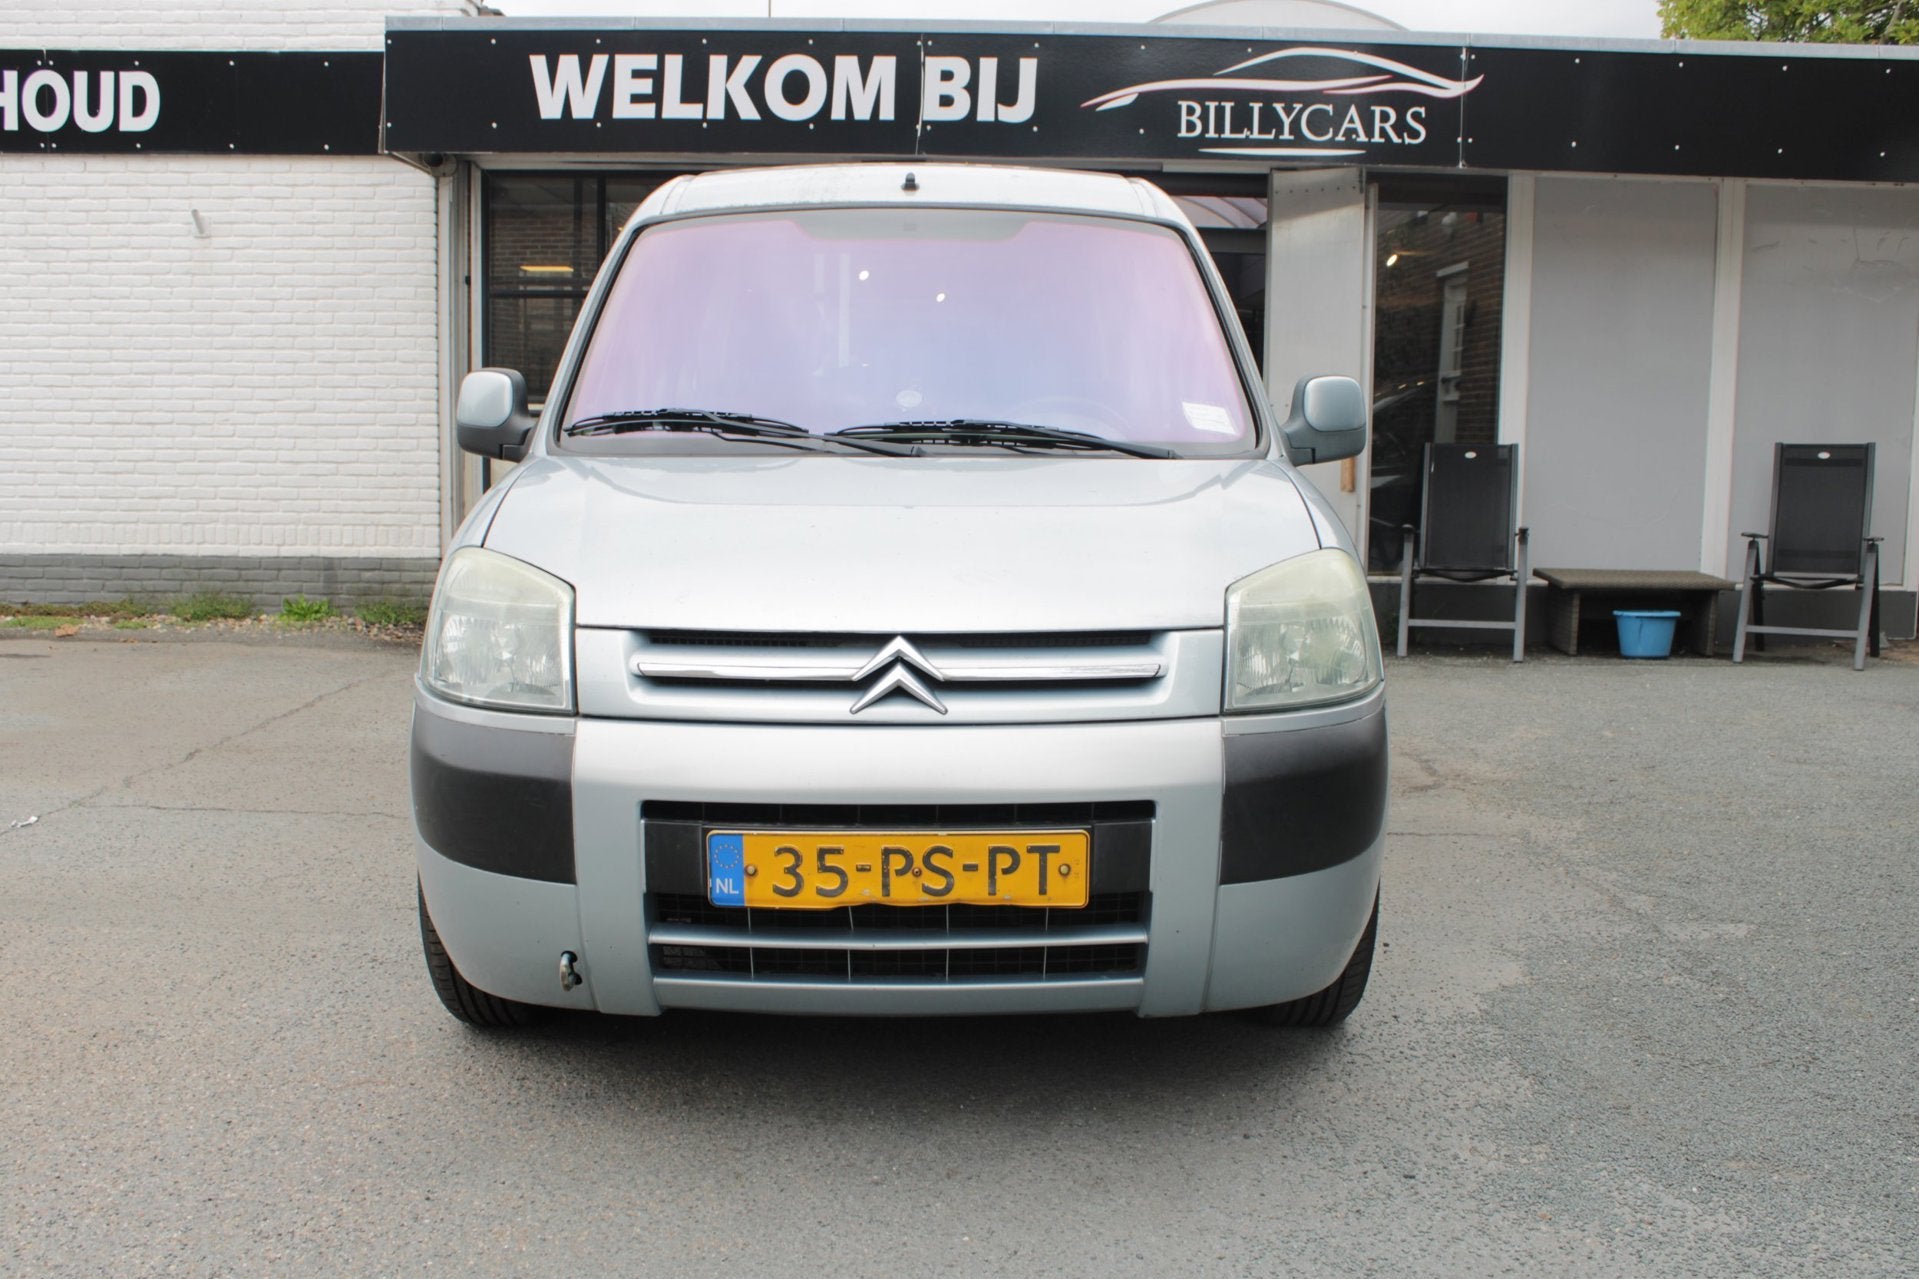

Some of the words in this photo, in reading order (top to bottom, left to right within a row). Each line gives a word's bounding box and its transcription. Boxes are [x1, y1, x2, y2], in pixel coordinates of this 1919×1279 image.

[529, 53, 897, 121] WELKOM
[923, 55, 1038, 123] BIJ
[1176, 100, 1427, 144] BILLYCARS
[714, 880, 740, 895] NL
[772, 844, 1061, 898] 35-PS-PT
